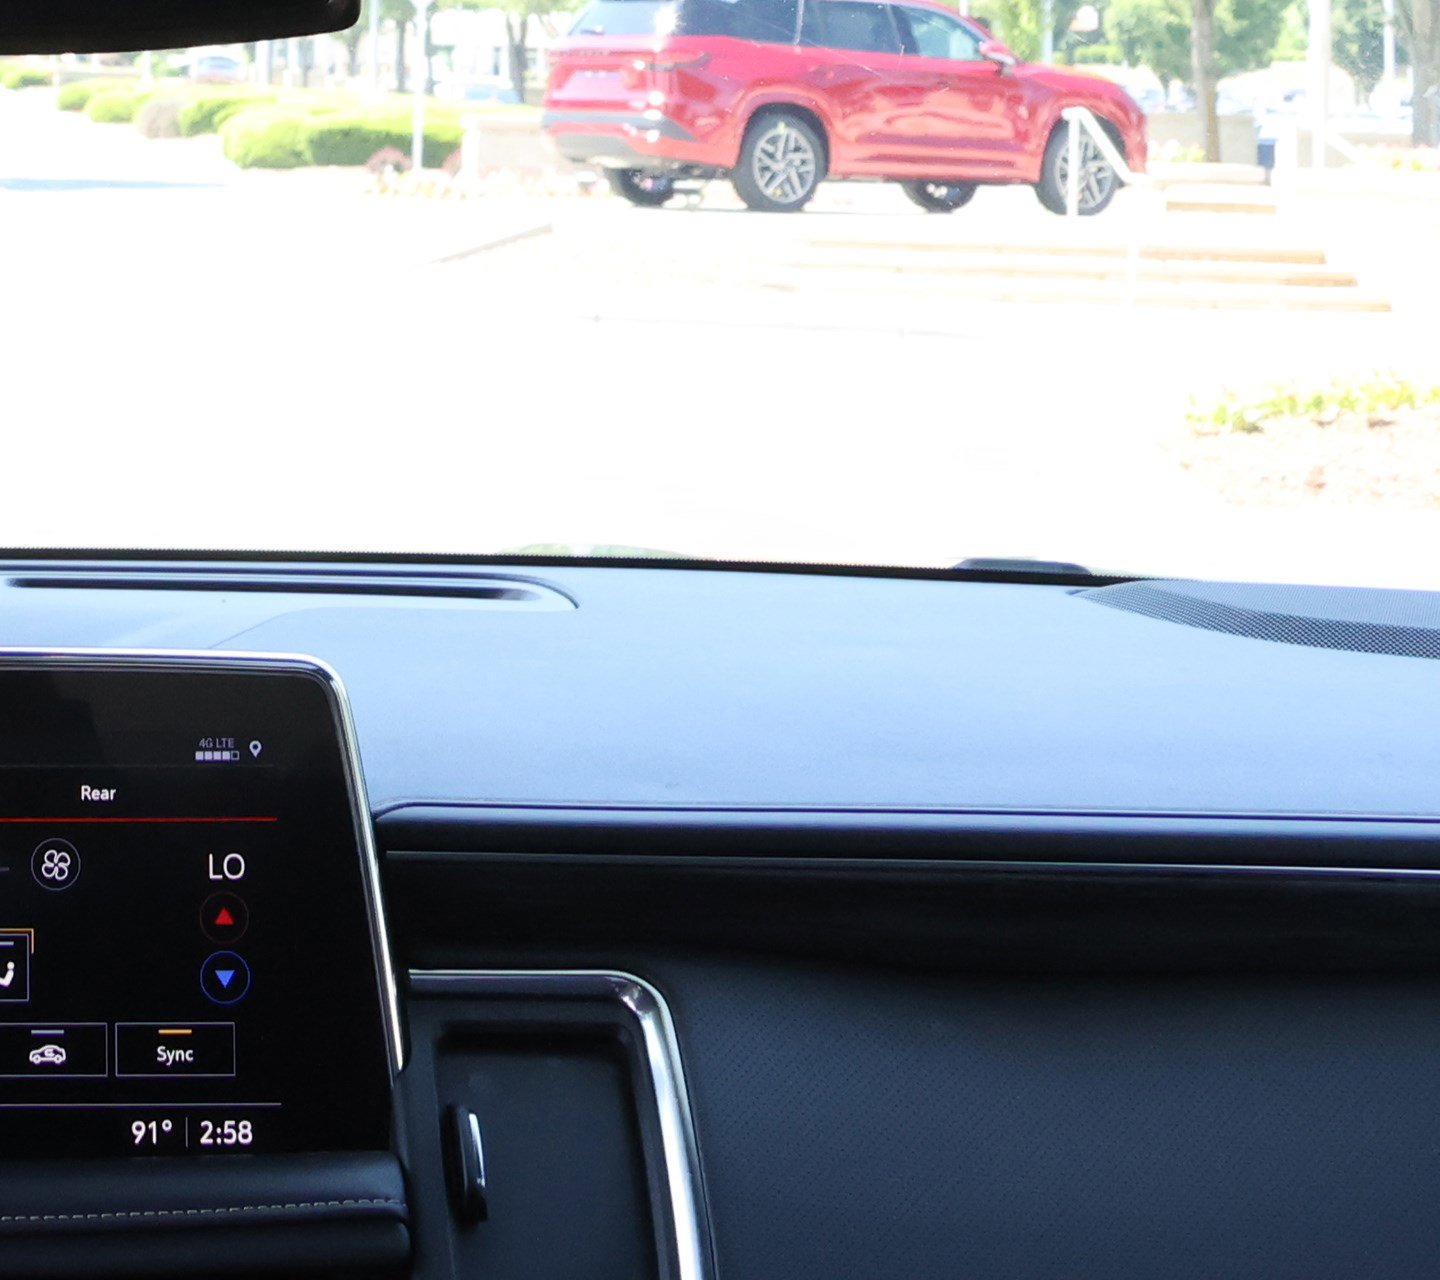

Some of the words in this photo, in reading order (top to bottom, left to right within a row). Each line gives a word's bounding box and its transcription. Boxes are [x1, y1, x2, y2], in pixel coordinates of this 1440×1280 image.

[198, 737, 213, 750] 4G
[215, 737, 235, 750] LTE
[80, 784, 117, 802] Rear
[207, 853, 246, 883] LO
[156, 1045, 195, 1068] Sync
[130, 1119, 173, 1147] 91°
[199, 1119, 254, 1147] 2:58
